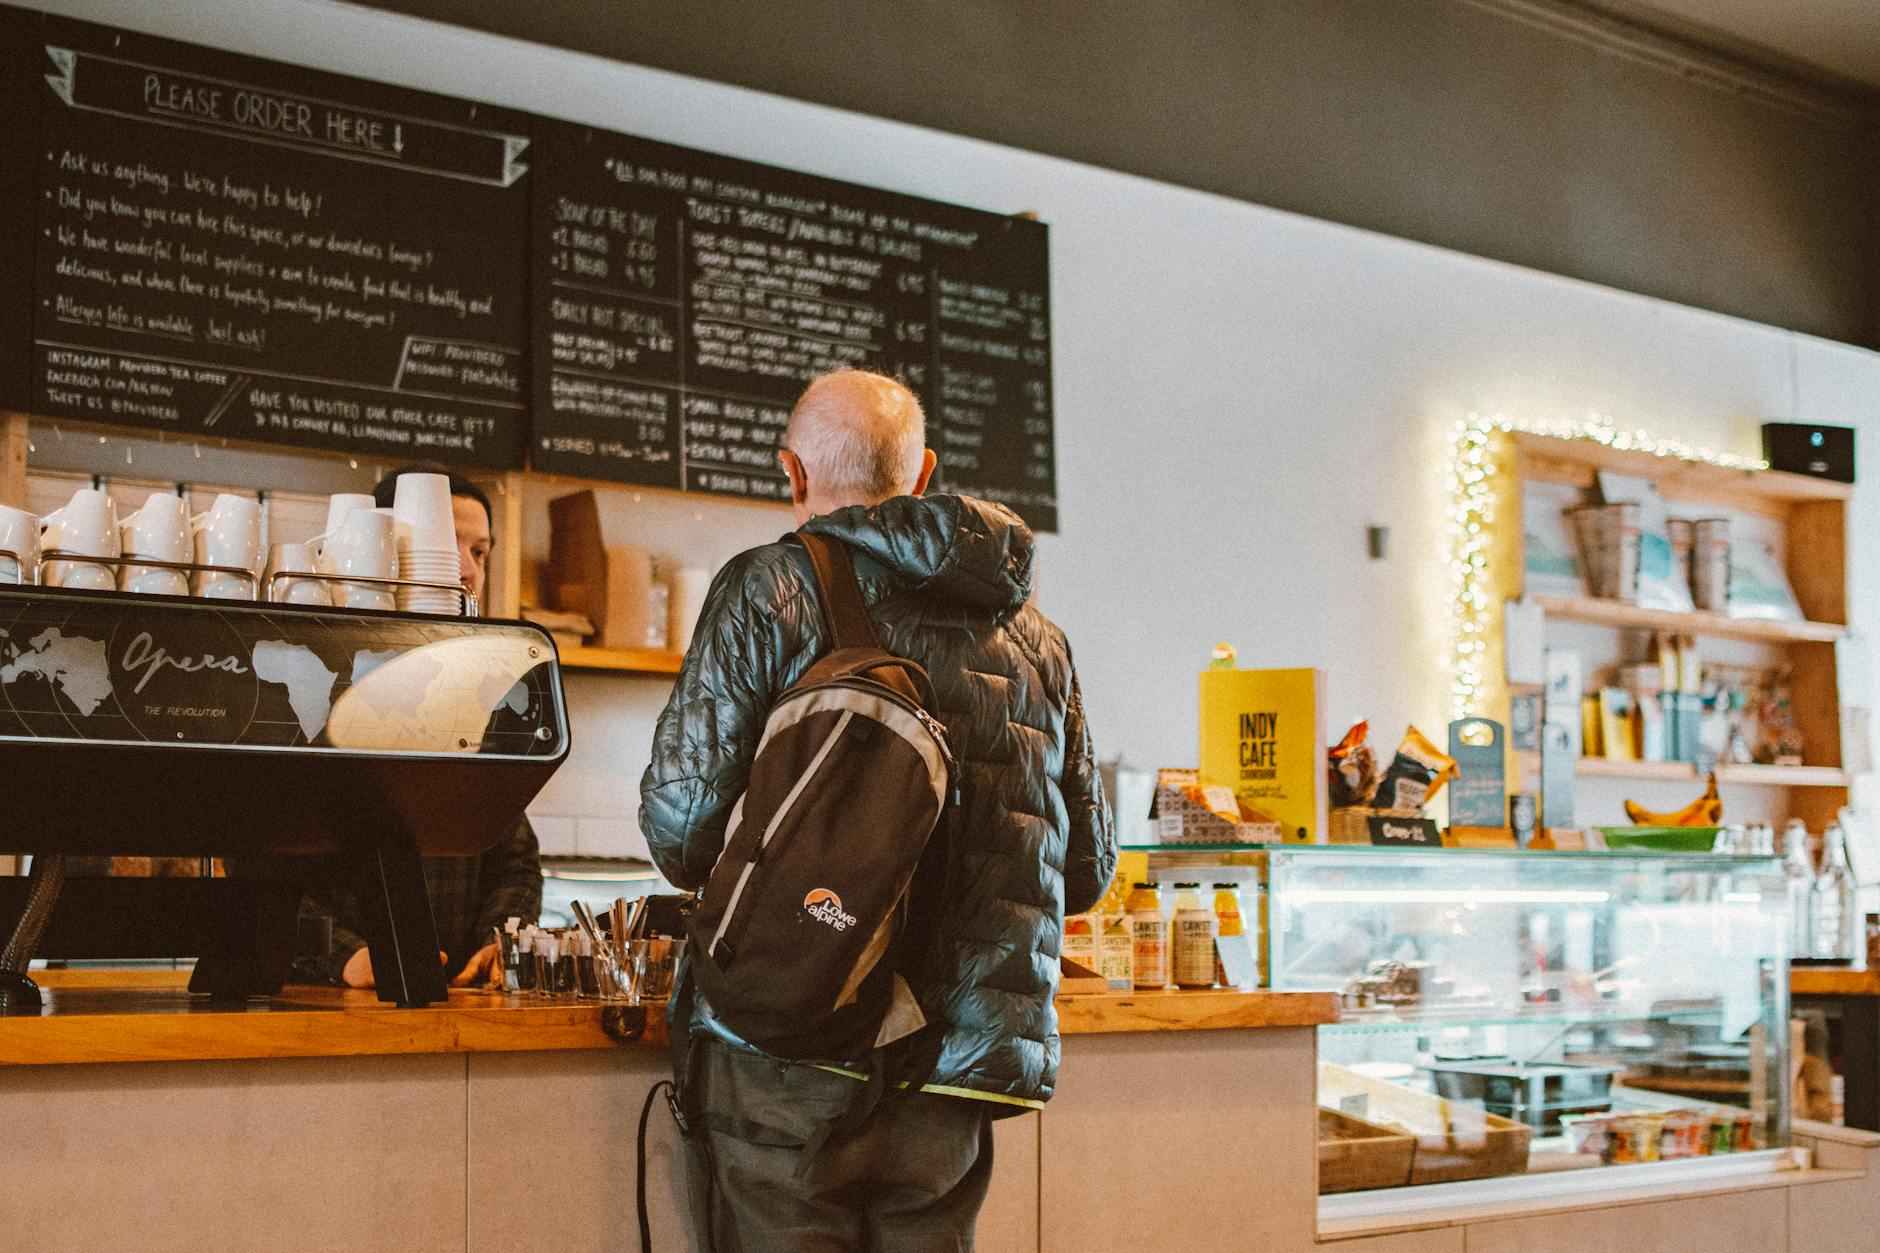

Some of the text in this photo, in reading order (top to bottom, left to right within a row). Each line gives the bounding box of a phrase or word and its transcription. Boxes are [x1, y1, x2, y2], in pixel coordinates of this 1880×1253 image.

[144, 76, 383, 150] PLEASE ORDER HERE
[60, 150, 87, 173] Ask
[91, 161, 108, 176] us
[184, 171, 217, 196] We're
[223, 176, 257, 210] happy
[264, 183, 279, 206] to
[58, 186, 81, 209] Did
[86, 197, 106, 220] you
[111, 196, 140, 217] know
[144, 206, 166, 229] you
[170, 211, 192, 226] can
[197, 208, 218, 233] hire
[223, 218, 246, 238] this
[57, 224, 76, 246] We
[82, 228, 108, 252] have
[114, 237, 172, 264] wonderful
[180, 243, 208, 266] local
[214, 254, 264, 279] suppliers
[307, 265, 319, 285] to
[362, 275, 385, 302] food
[389, 280, 411, 301] that
[413, 288, 425, 303] is
[428, 284, 466, 319] healthy
[469, 295, 492, 315] and
[121, 269, 143, 288] and
[180, 274, 203, 295] there
[208, 284, 220, 299] is
[325, 301, 340, 321] for
[56, 294, 102, 322] Allergen
[134, 315, 144, 328] is
[148, 315, 194, 336] available
[48, 351, 111, 371] INSTAGRAM
[48, 388, 83, 406] TWEET
[87, 397, 103, 409] US
[250, 389, 281, 409] HAVE
[287, 394, 310, 412] YOU
[314, 398, 359, 419] VISITED
[366, 406, 387, 420] OUR
[392, 407, 423, 426] OTHER
[122, 631, 248, 694] Opera
[144, 705, 227, 718] THE REVOLUTION
[1240, 712, 1277, 738] INDY
[1240, 742, 1277, 767] CAFE
[808, 905, 846, 931] alpine
[822, 900, 856, 926] Lowe
